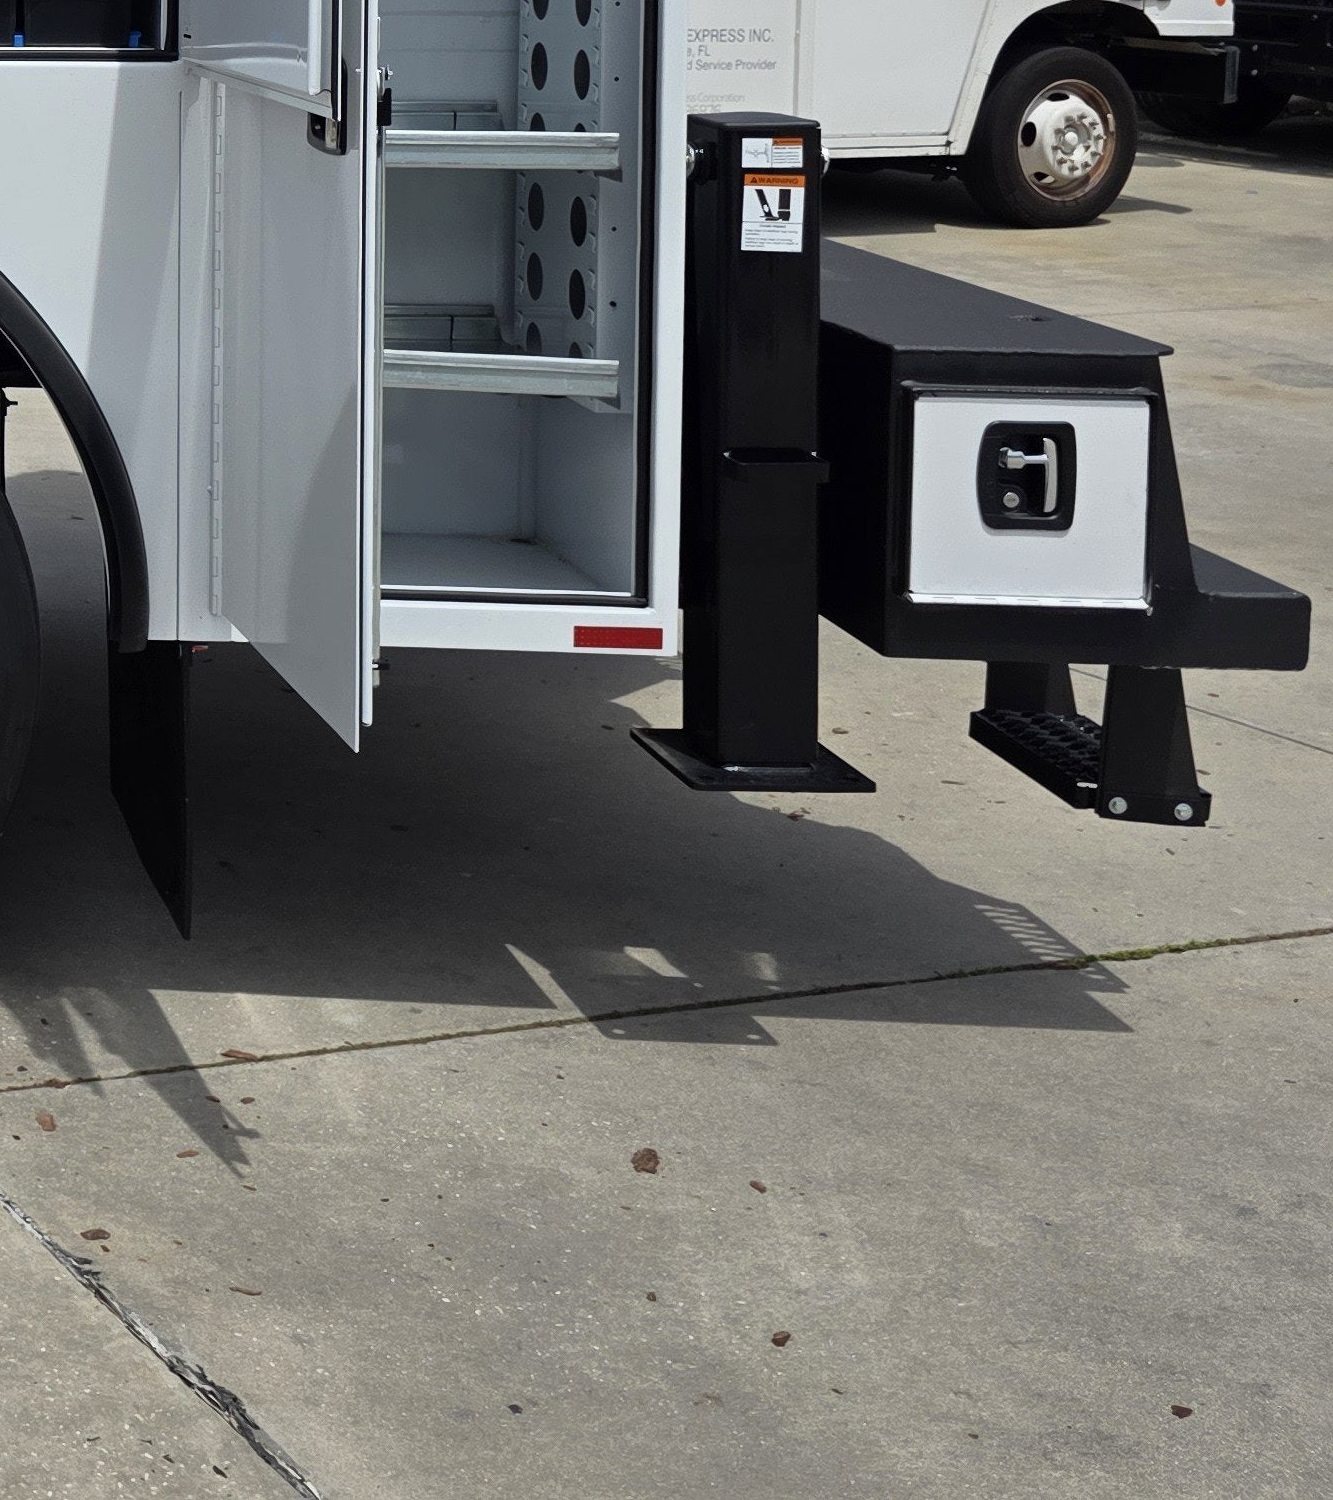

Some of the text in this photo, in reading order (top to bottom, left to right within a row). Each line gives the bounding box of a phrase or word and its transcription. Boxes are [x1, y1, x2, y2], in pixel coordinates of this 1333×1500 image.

[686, 28, 775, 43] EXPRESS INC.
[697, 45, 712, 57] FL
[695, 59, 733, 71] Service
[735, 59, 777, 71] Provider
[758, 177, 799, 185] WARNING
